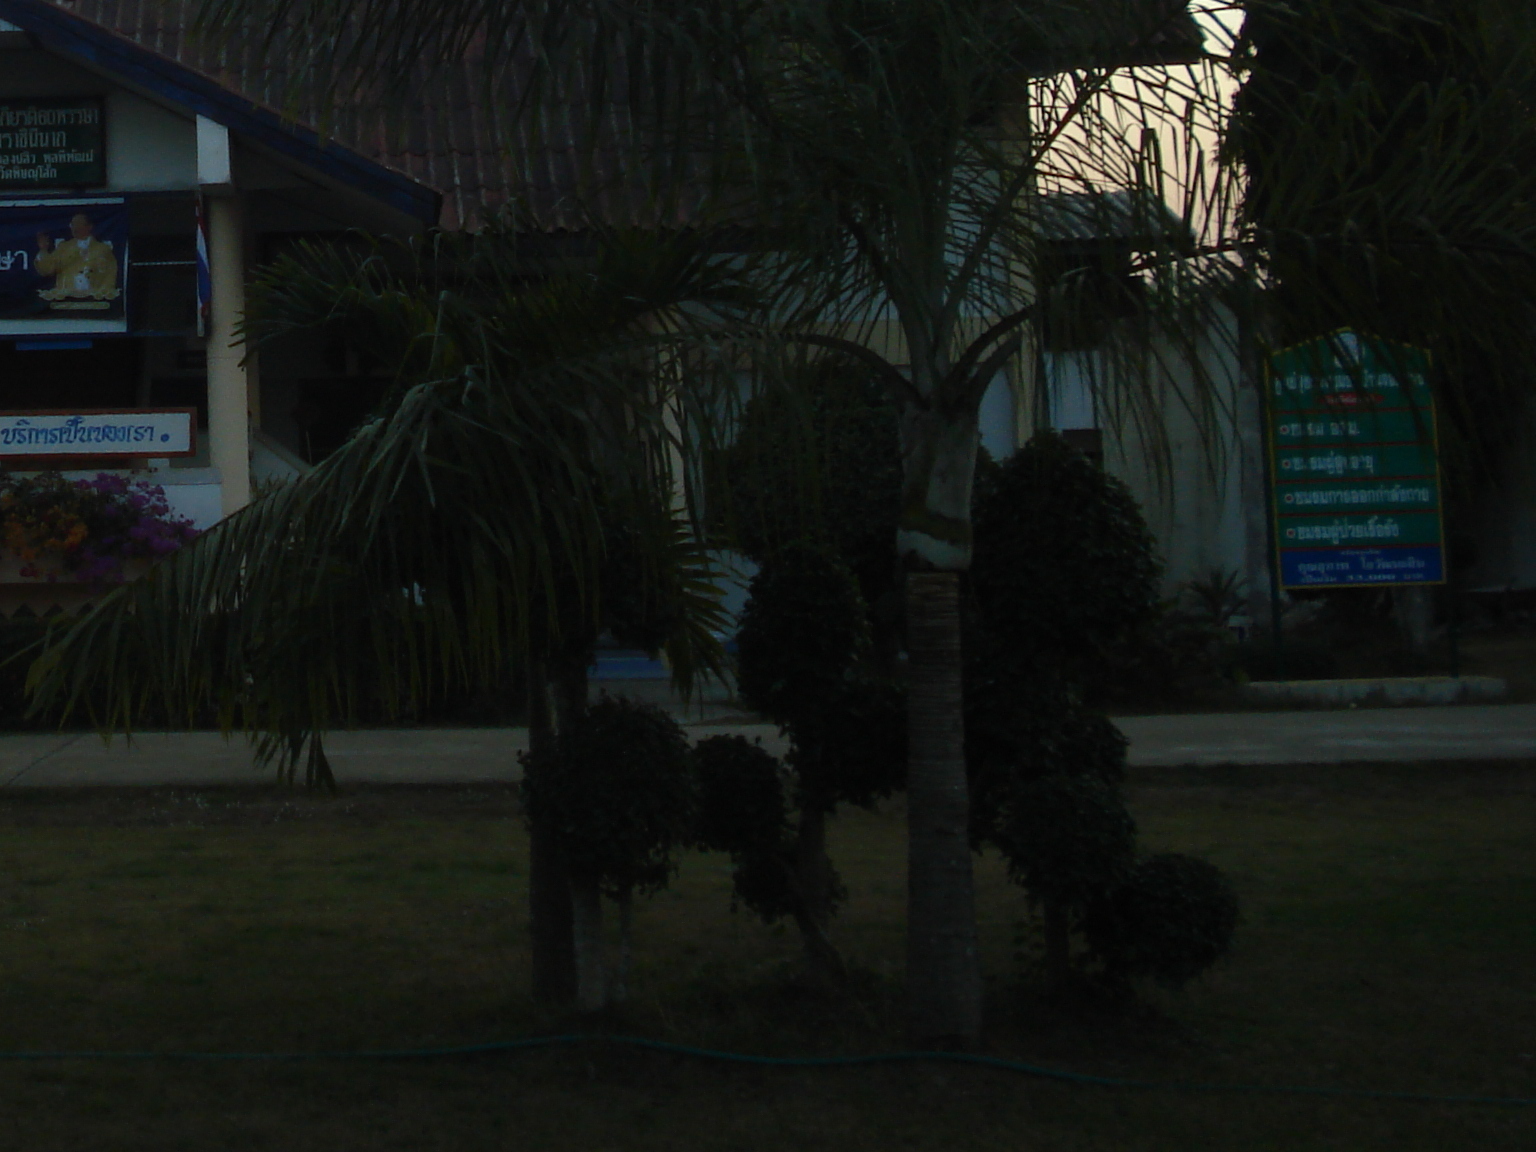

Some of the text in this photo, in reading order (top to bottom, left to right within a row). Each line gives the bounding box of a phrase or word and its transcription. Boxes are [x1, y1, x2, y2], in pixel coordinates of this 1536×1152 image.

[0, 415, 155, 445] บริการเป็นของเรา
